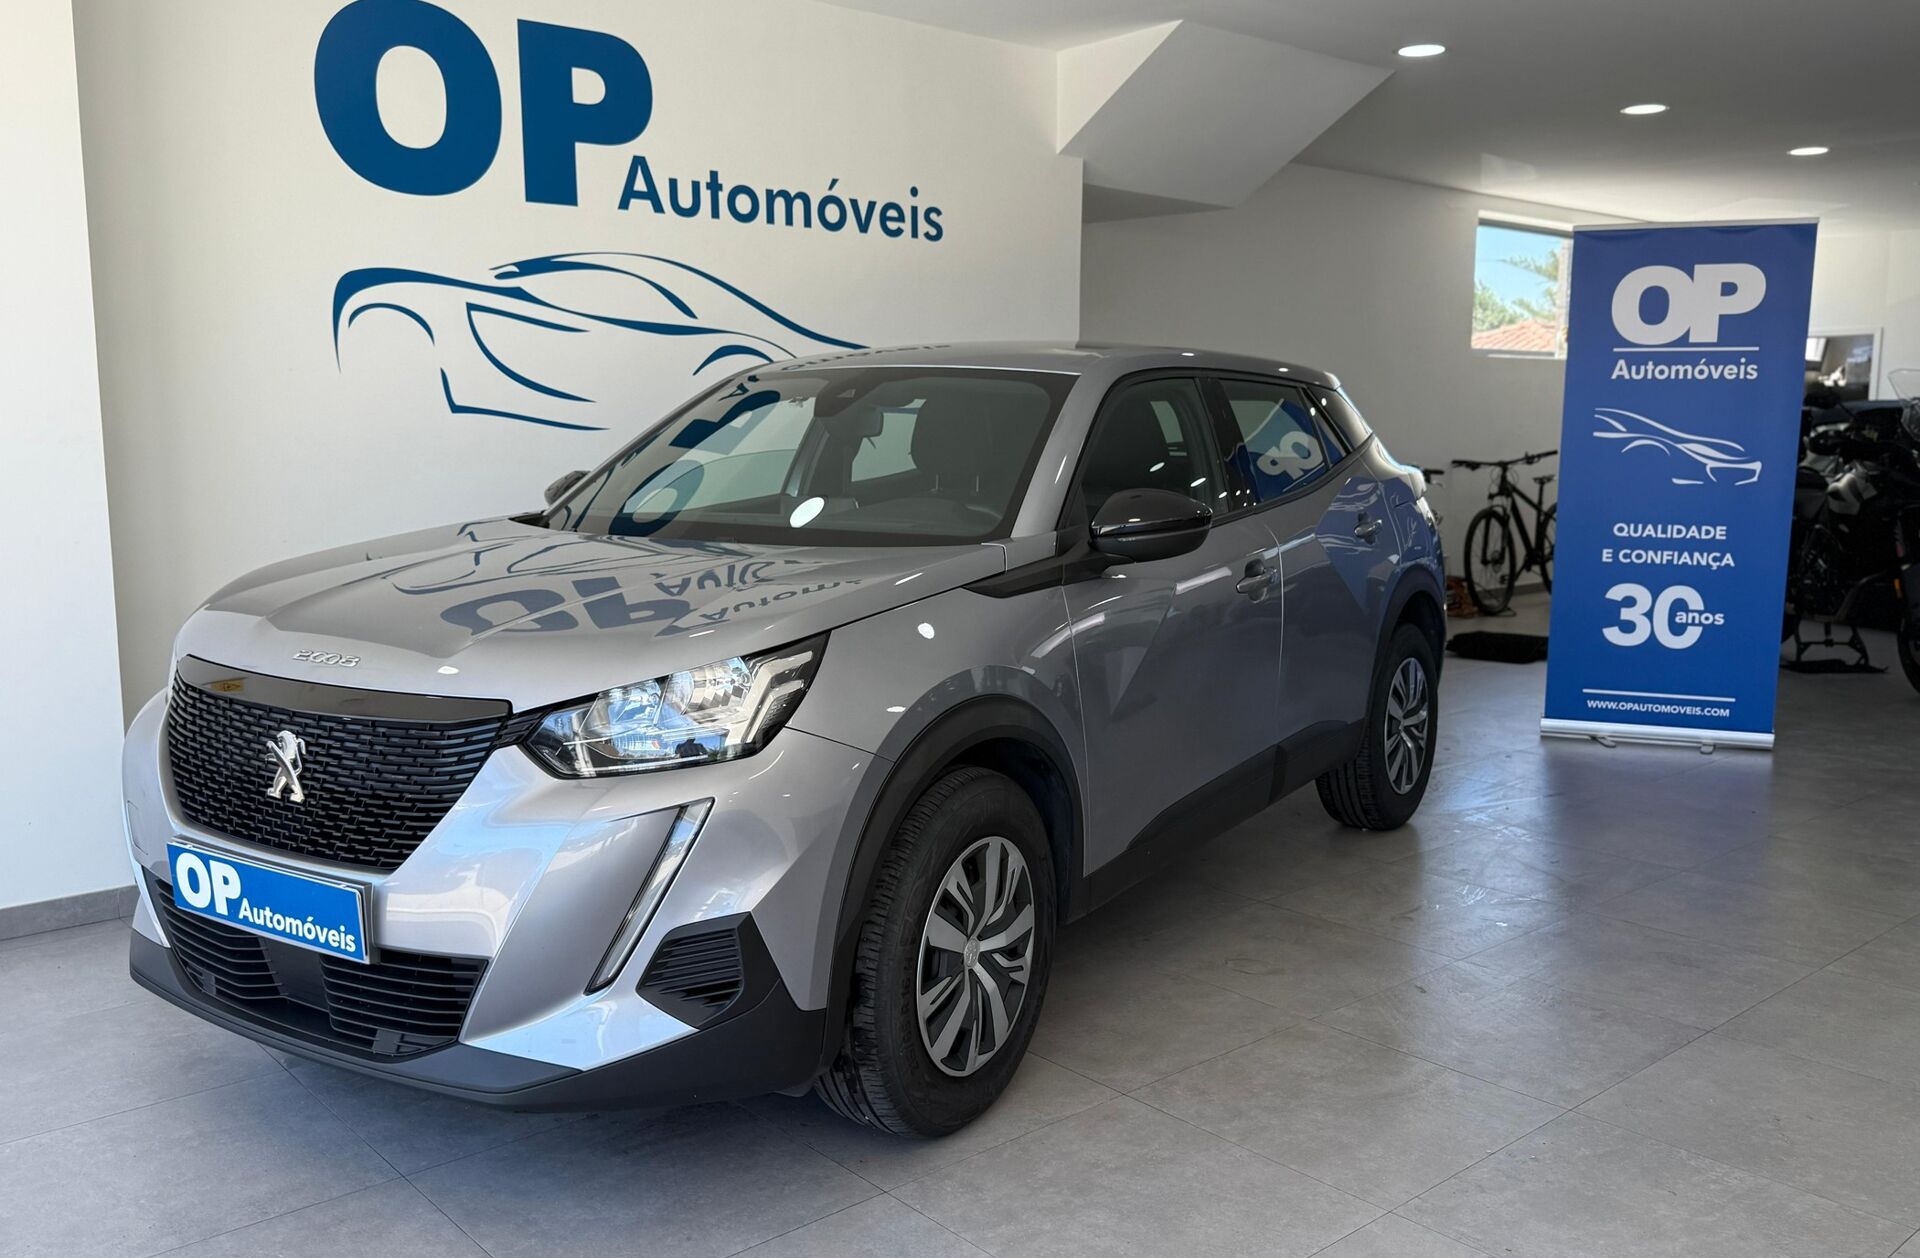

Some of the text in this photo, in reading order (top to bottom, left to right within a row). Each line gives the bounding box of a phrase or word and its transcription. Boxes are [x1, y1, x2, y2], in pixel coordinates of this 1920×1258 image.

[314, 0, 653, 207] OP
[617, 155, 944, 242] Automóveis
[1611, 263, 1766, 345] OP
[1611, 357, 1758, 380] Automóveis
[1613, 522, 1727, 540] QUALIDADE
[1602, 549, 1735, 570] E CONFIANÇA
[1602, 582, 1725, 650] 30 anos
[292, 649, 361, 668] 2008
[1586, 700, 1730, 717] WWW.OPAUTOMOVEIS.COM
[175, 852, 242, 916] OP
[238, 898, 357, 953] Automóveis
